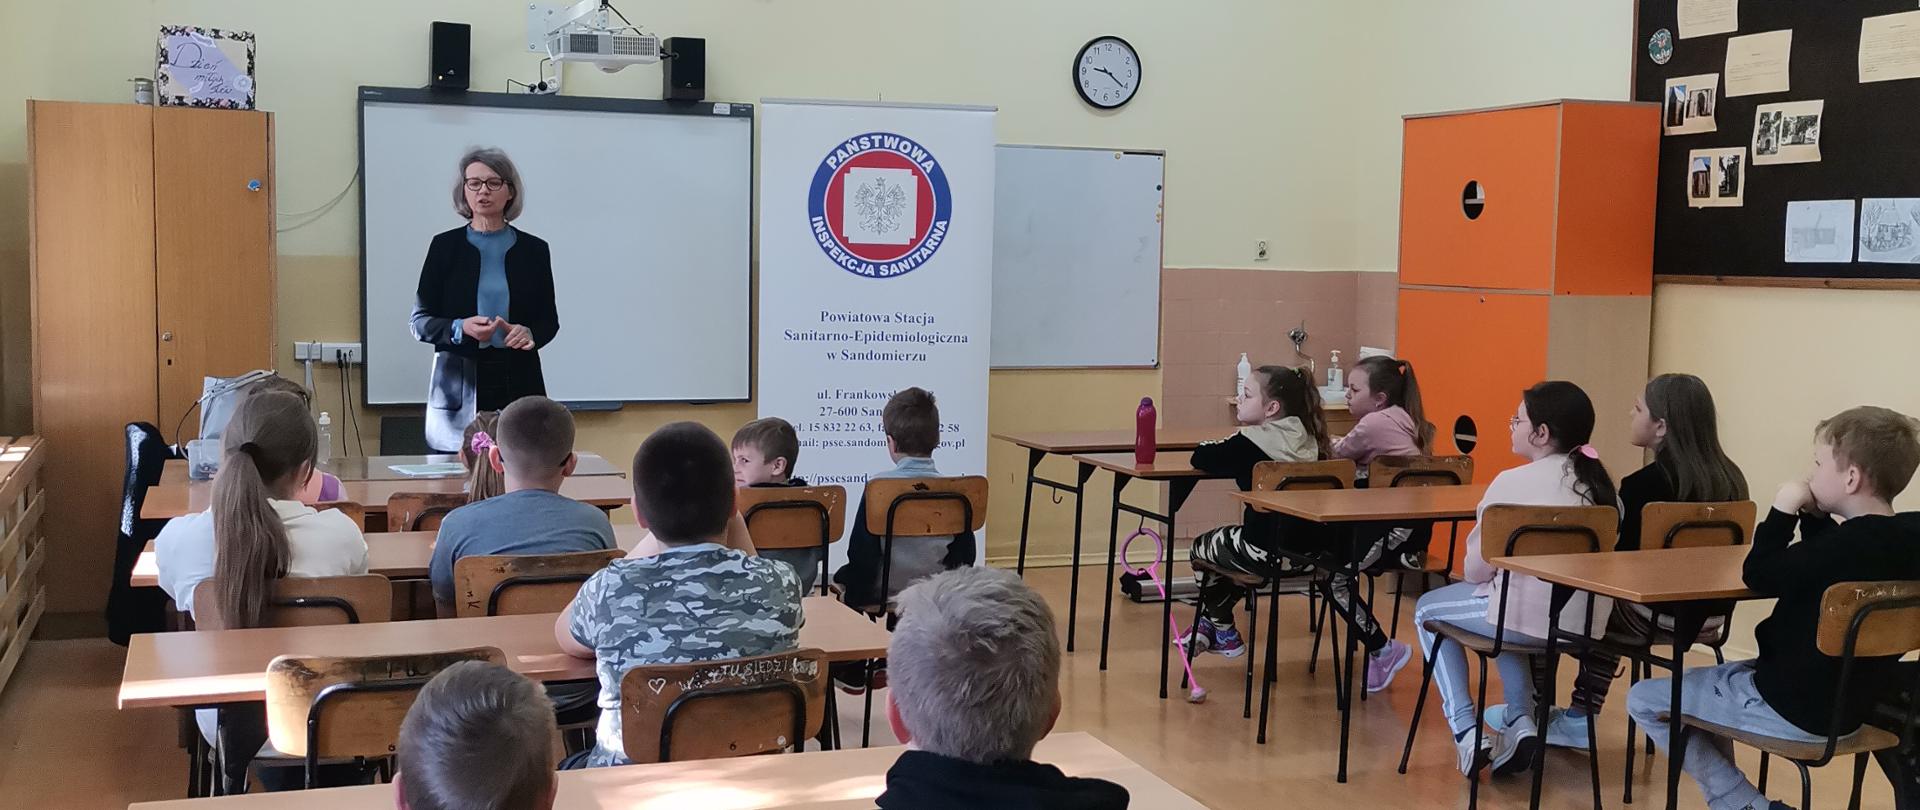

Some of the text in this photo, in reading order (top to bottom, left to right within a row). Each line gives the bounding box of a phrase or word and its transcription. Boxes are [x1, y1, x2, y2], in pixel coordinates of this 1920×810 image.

[1093, 47, 1100, 55] 11
[1104, 43, 1112, 51] 12
[1086, 56, 1093, 64] 10
[1125, 56, 1130, 64] 2
[1081, 67, 1087, 75] 9
[1127, 69, 1132, 77] 3
[1084, 80, 1089, 88] 8
[1093, 88, 1098, 96] 7
[1115, 89, 1121, 98] 5
[1103, 93, 1109, 101] 6
[826, 135, 935, 173] PAŃSTWOWA
[812, 216, 948, 276] INSPEKCJA SANITARNA
[820, 311, 935, 326] Powiatowa Stacja
[784, 329, 969, 345] Sanitarno-Epidemiologiczna
[841, 350, 927, 362] Sandomierzu
[817, 389, 831, 399] ul.
[819, 406, 858, 416] 27-600
[809, 423, 820, 431] 15
[823, 423, 841, 431] 832
[844, 423, 856, 431] 22
[859, 423, 874, 432] 63,
[948, 424, 960, 432] 58
